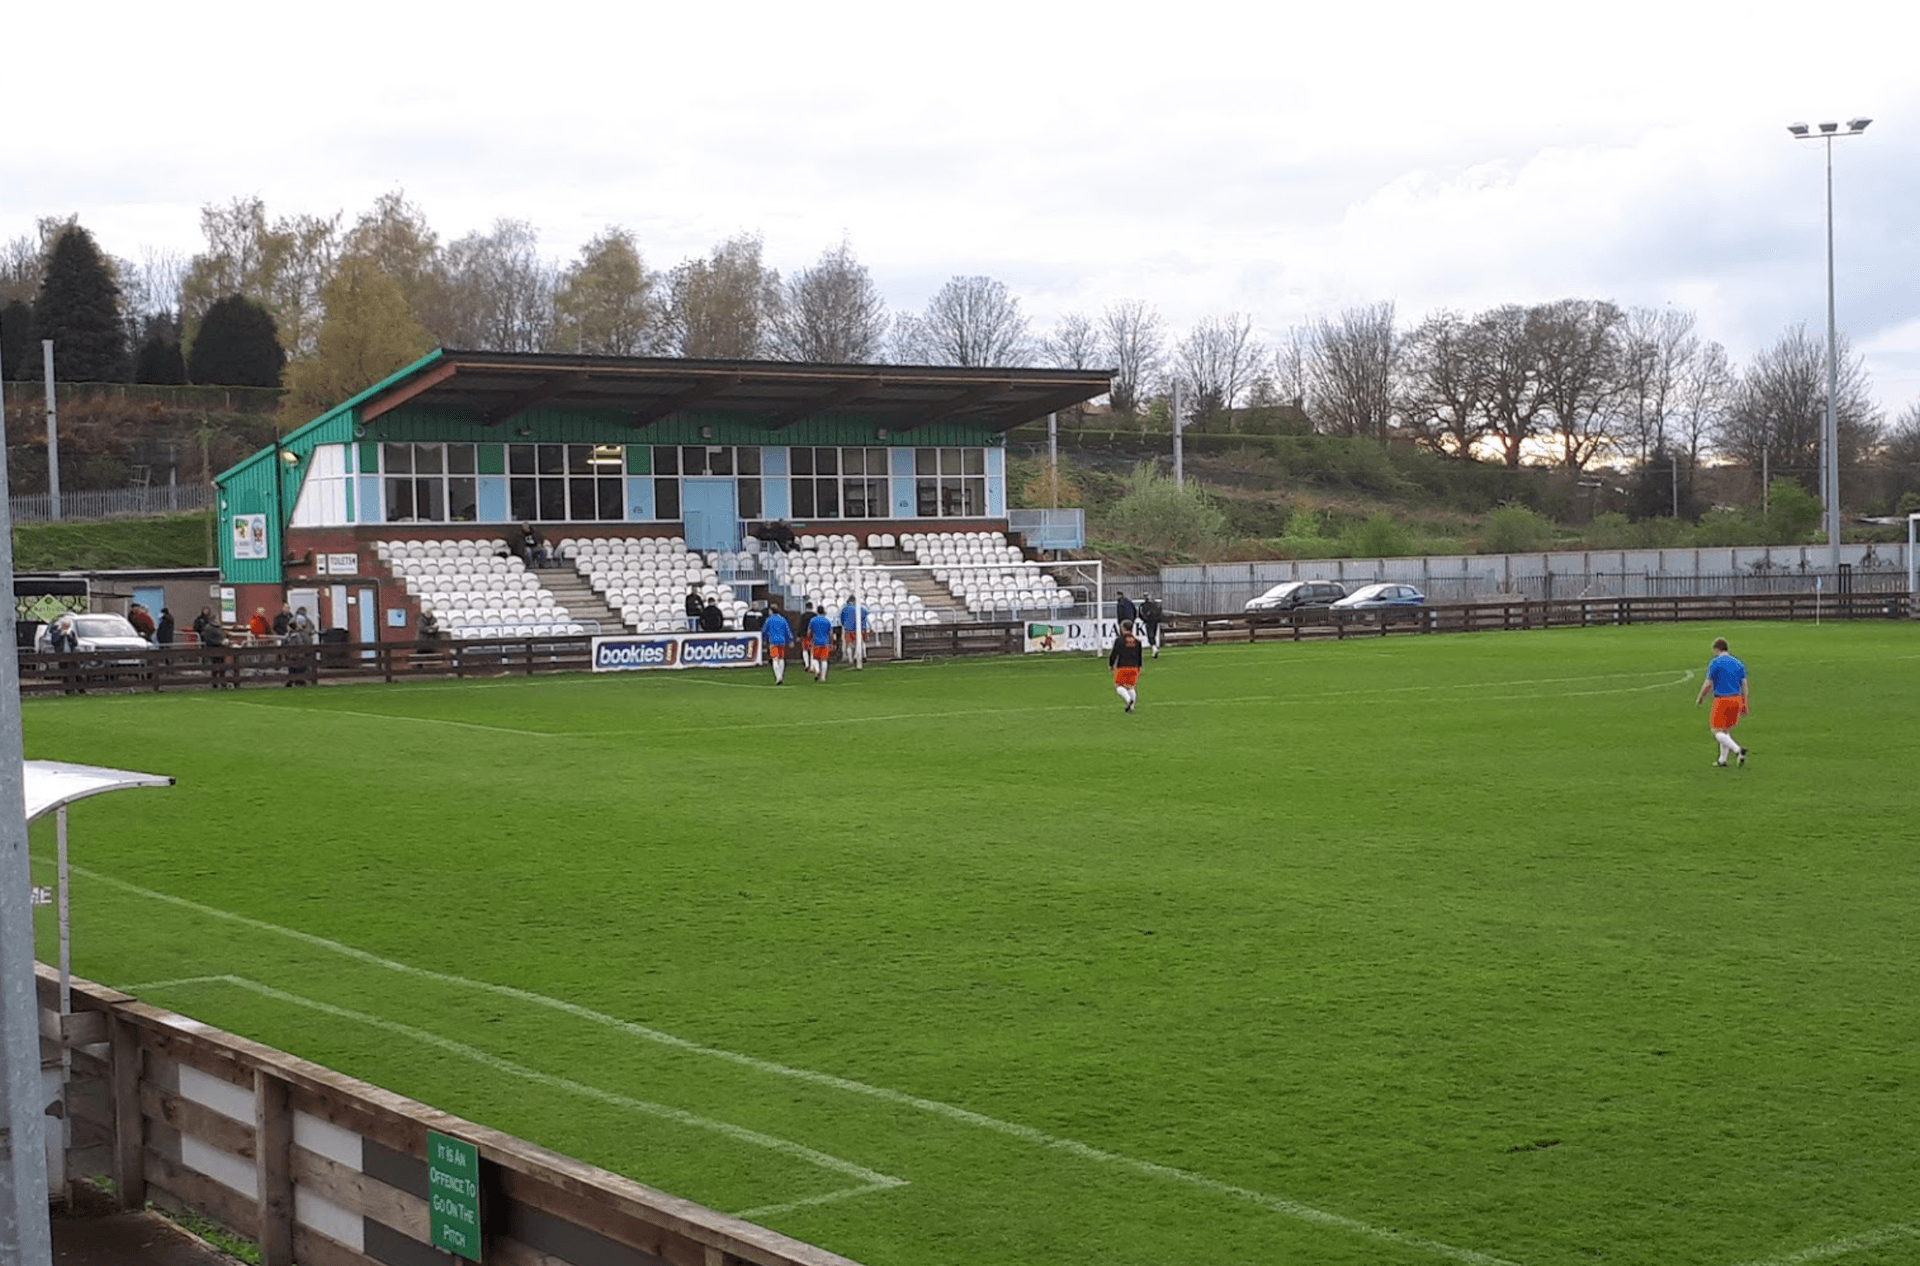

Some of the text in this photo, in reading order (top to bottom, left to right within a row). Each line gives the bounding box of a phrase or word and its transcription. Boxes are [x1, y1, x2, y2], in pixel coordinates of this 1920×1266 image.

[330, 556, 352, 565] TOILETS
[1091, 621, 1147, 638] MAK
[600, 644, 664, 664] bookies
[684, 641, 745, 661] bookies
[437, 1142, 467, 1167] IT IS AN
[430, 1166, 476, 1198] OFFENCE TO
[433, 1194, 475, 1224] GO ON THE
[443, 1223, 466, 1248] PITCH
